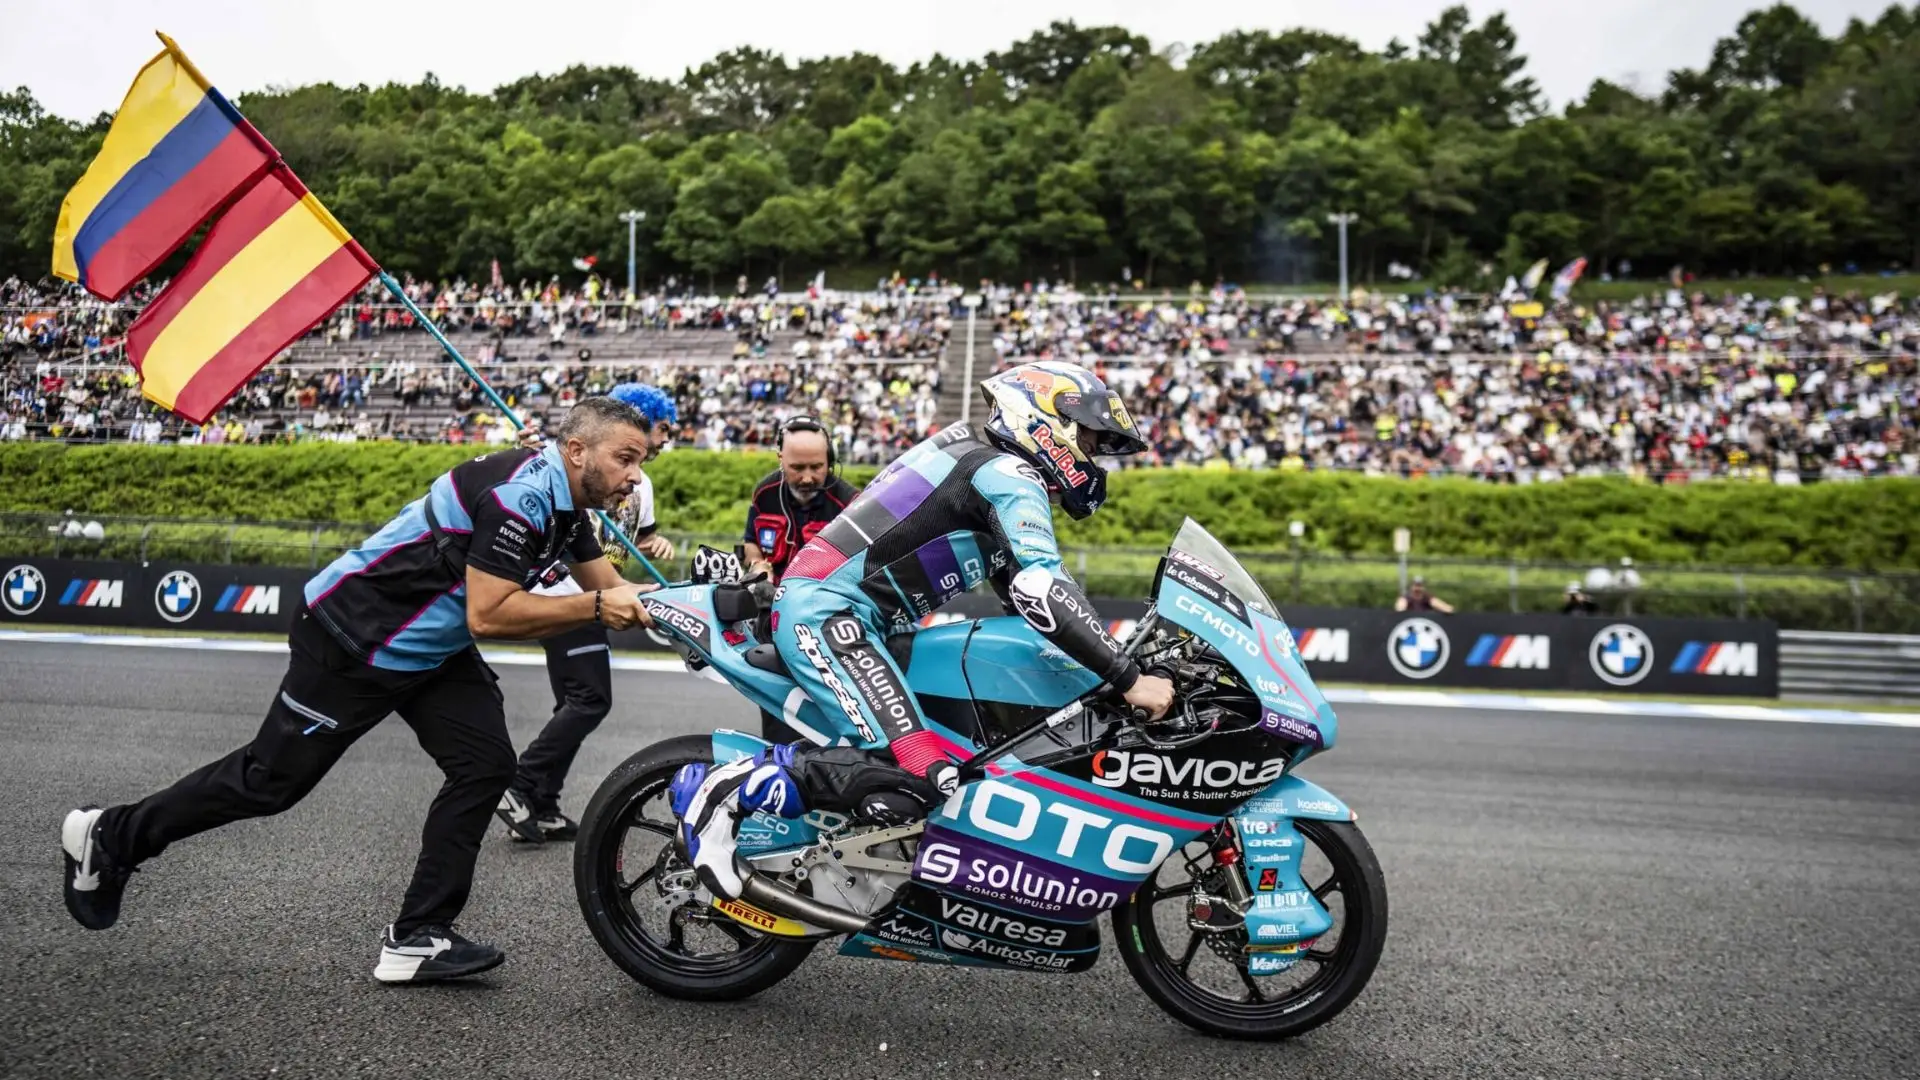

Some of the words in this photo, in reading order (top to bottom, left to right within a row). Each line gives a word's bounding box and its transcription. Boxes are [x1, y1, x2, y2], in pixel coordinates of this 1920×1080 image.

[1031, 423, 1069, 461] Red
[1056, 453, 1089, 489] Bull
[1178, 571, 1220, 599] Cabanon
[646, 599, 705, 638] valresa
[1049, 584, 1119, 652] gaviota
[1175, 595, 1261, 658] CFMOTO
[794, 624, 877, 743] alpinestars
[840, 656, 861, 680] SOMOS
[858, 678, 882, 711] IMPULSO
[851, 650, 913, 732] solunion
[1280, 718, 1317, 740] solunion
[1091, 750, 1285, 787] gaviota
[1139, 787, 1158, 797] The
[1161, 789, 1180, 799] Sun
[1182, 791, 1189, 799] &
[1192, 791, 1228, 800] Shutter
[965, 885, 1007, 901] SOMOS
[968, 859, 1119, 910] solunion
[719, 899, 777, 929] PIRELLI
[941, 898, 1068, 948] valresa
[879, 930, 899, 941] SOLER
[968, 938, 1076, 971] AutoSolar
